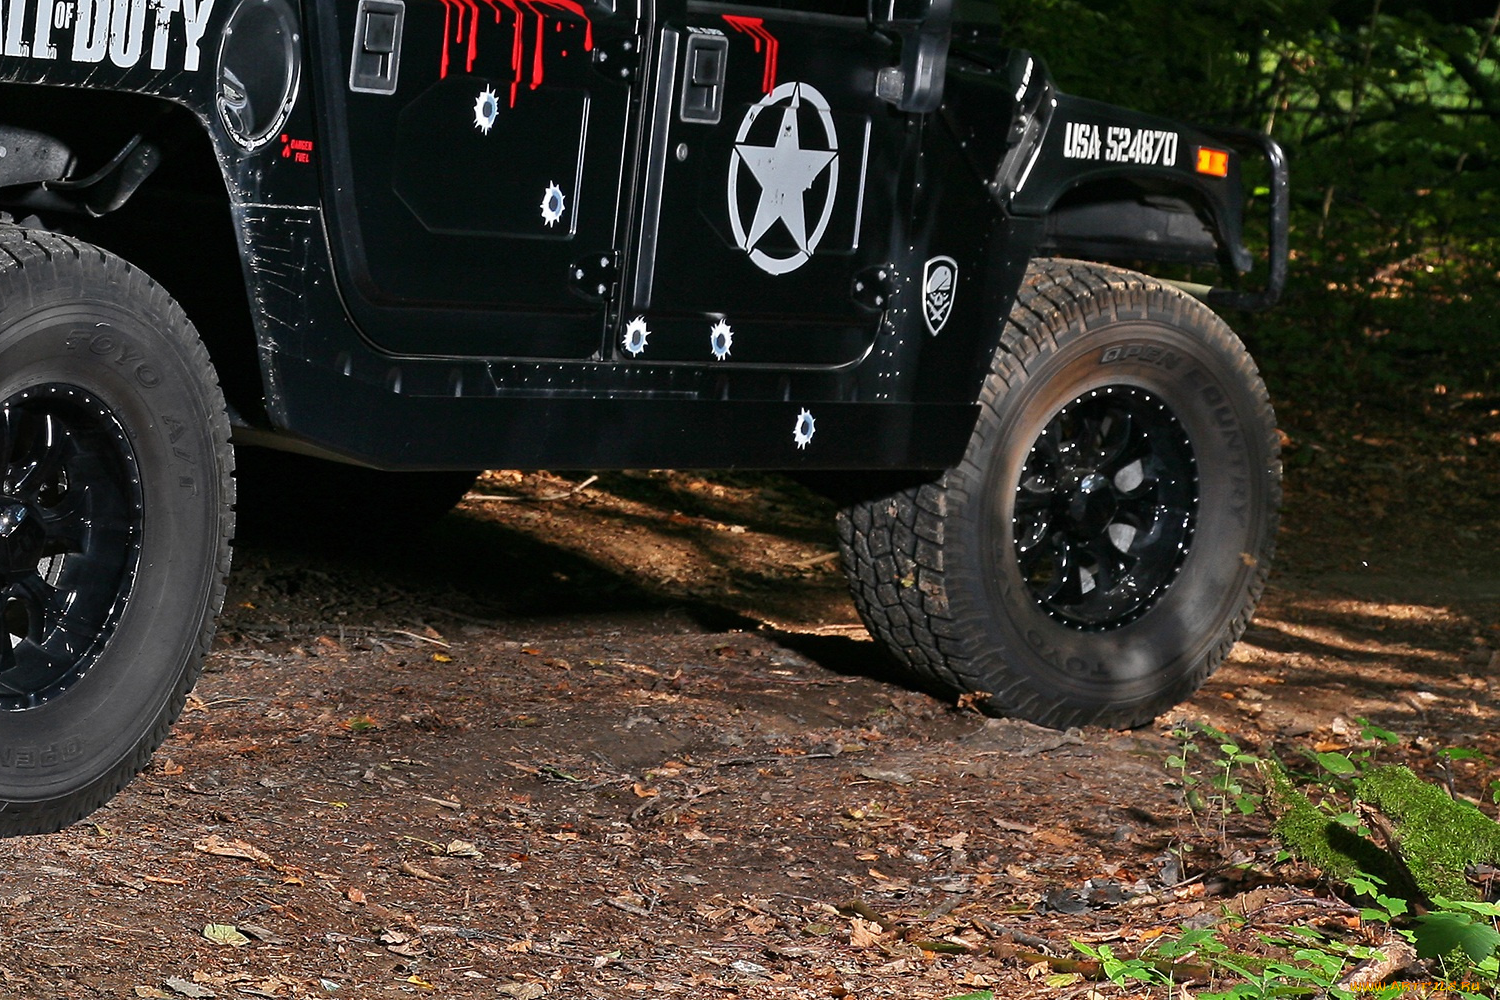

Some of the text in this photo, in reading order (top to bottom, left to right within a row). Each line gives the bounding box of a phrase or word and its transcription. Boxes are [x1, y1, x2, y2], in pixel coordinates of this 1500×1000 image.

[55, 1, 74, 29] OF
[295, 152, 309, 163] FUEL
[1063, 122, 1178, 167] USA 524870
[65, 328, 161, 389] TOYO
[1098, 342, 1180, 371] OPEN
